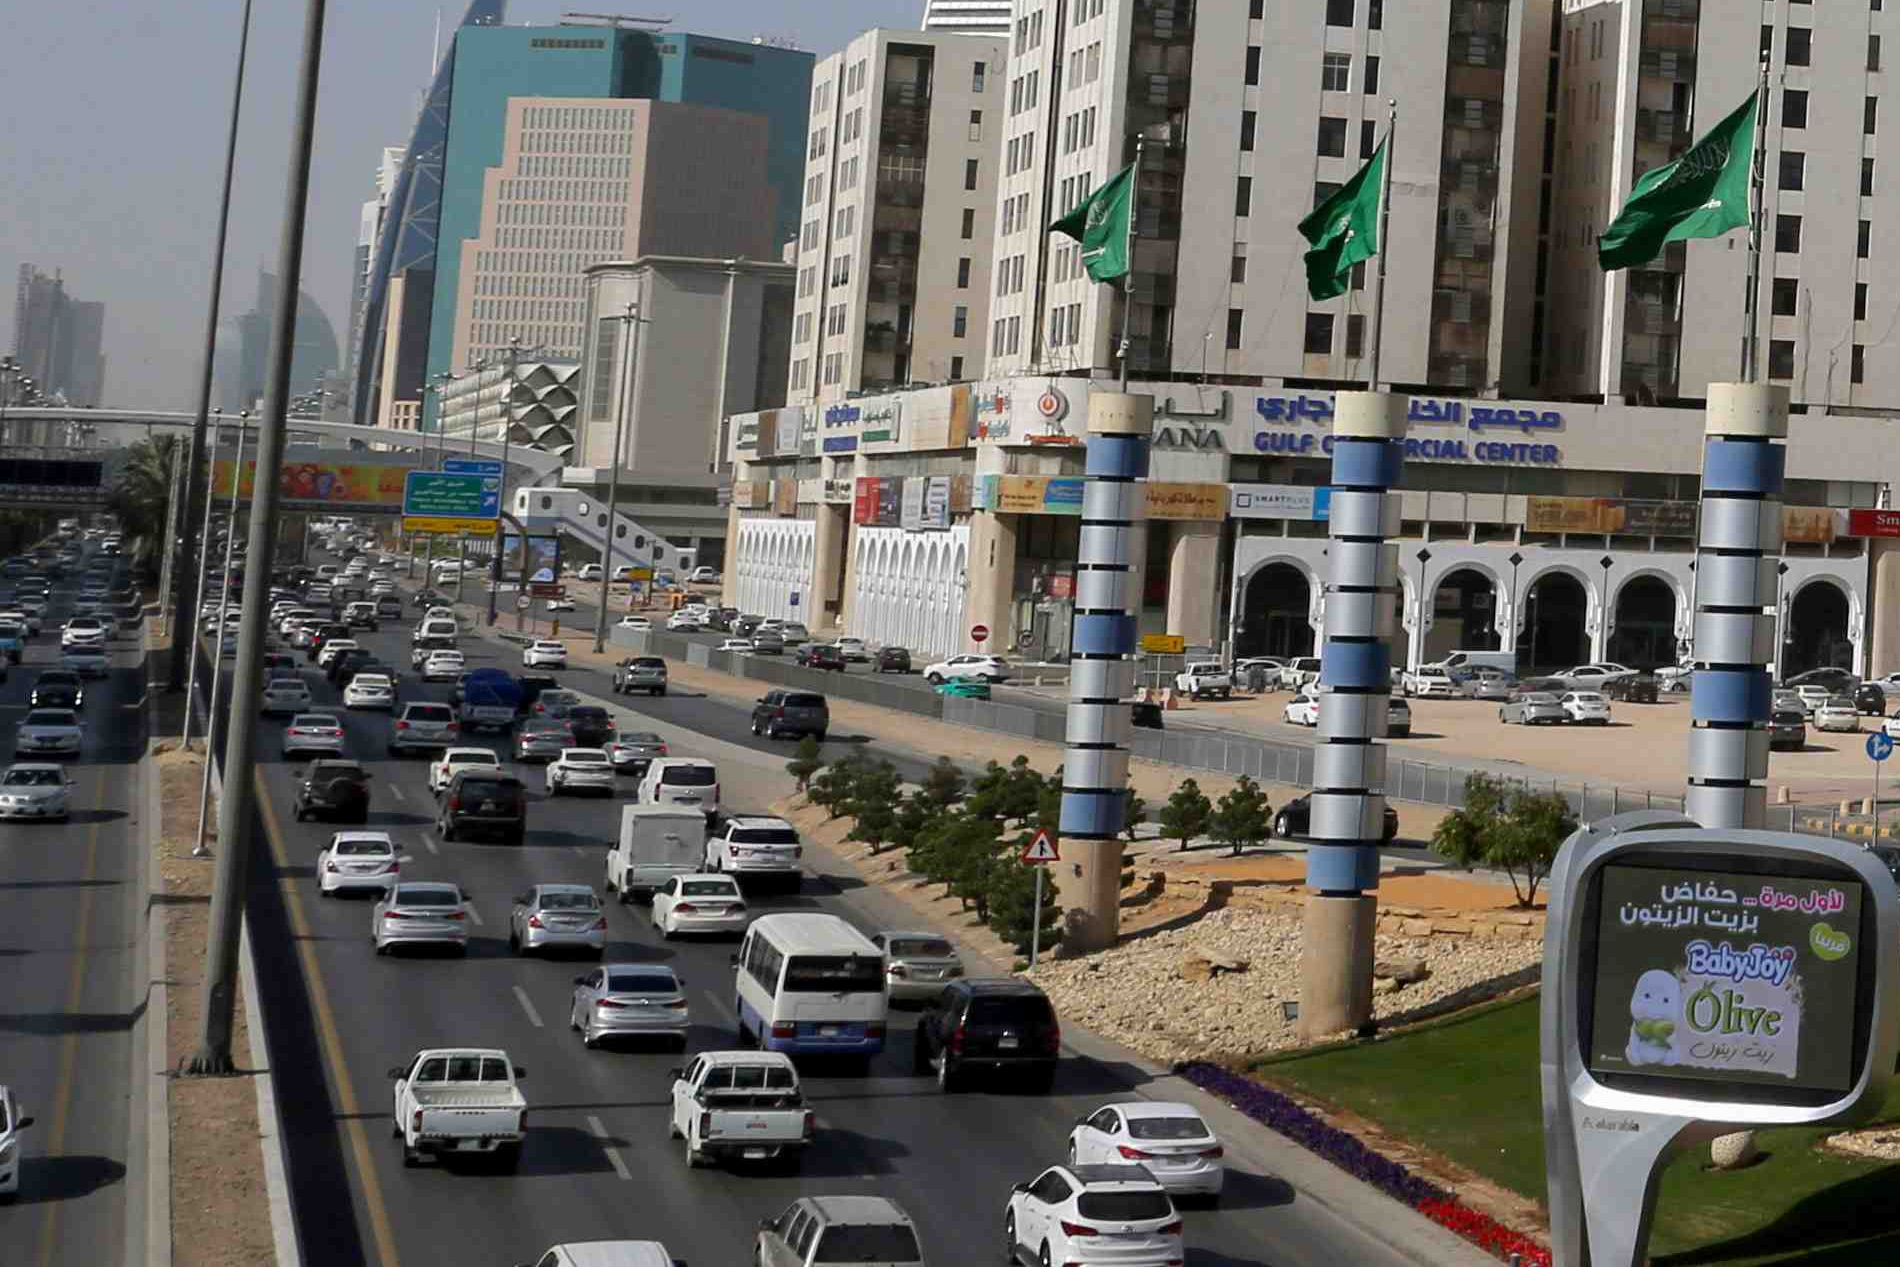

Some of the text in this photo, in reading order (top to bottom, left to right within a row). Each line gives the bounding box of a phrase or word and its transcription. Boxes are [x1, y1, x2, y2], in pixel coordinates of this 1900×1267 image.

[1257, 395, 1561, 433] مجمع الخل جاري
[1254, 432, 1314, 452] GULF
[1475, 442, 1559, 463] CENTER
[1661, 880, 1738, 906] حفاض
[1800, 889, 1845, 915] لأول
[1619, 901, 1760, 935] بزيت الزيتون
[1685, 982, 1783, 1037] Olive
